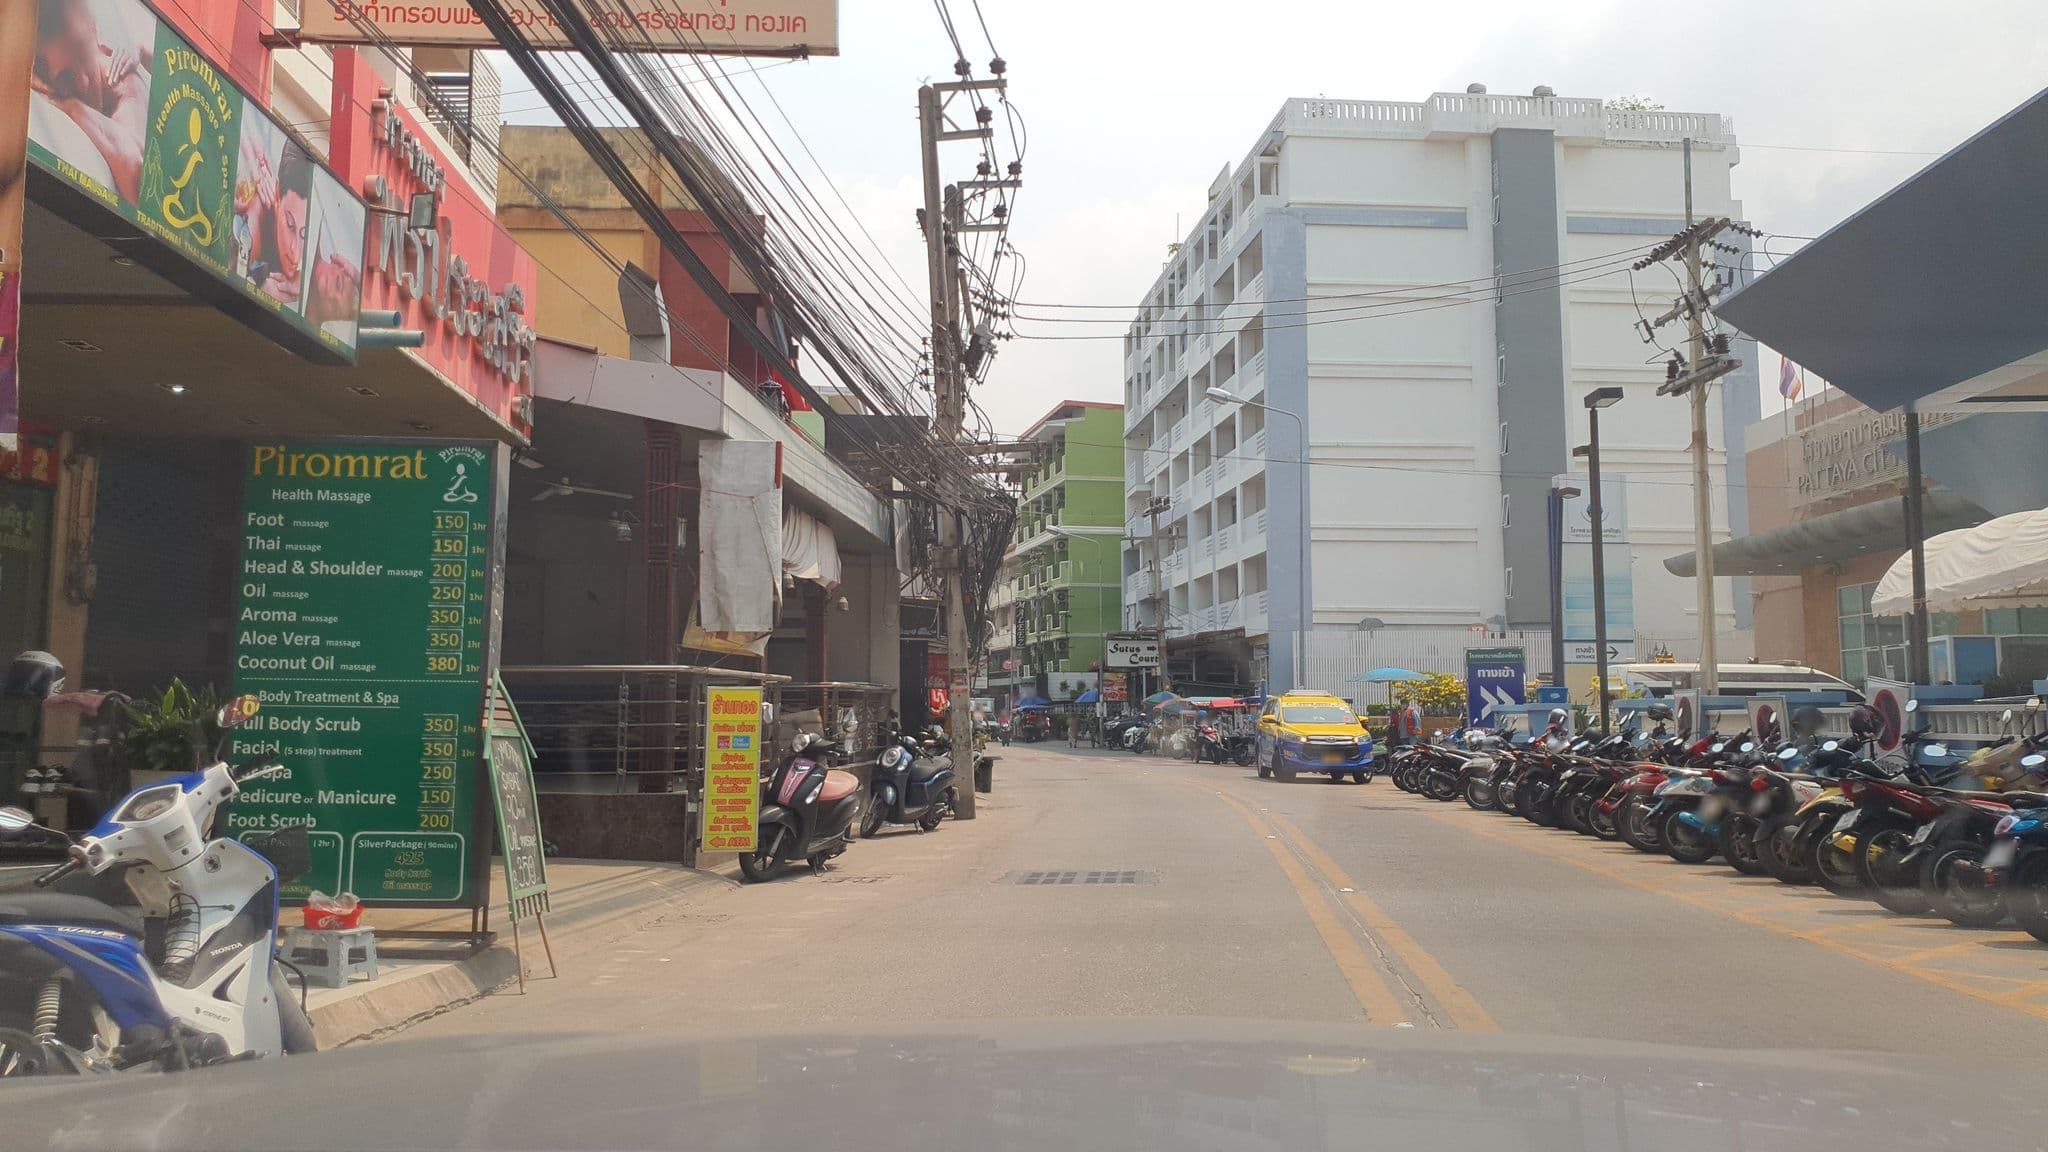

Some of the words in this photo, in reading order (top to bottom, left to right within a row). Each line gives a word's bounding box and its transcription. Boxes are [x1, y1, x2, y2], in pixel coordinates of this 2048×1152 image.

[745, 15, 807, 32] ทองเค
[165, 48, 233, 127] Piromrat
[156, 88, 181, 135] Health
[182, 83, 220, 130] Massage
[56, 158, 79, 181] THAI
[136, 209, 182, 246] TRADITIONAL
[253, 445, 428, 480] Piromrat
[1798, 457, 1859, 496] PATTAYA
[1862, 447, 1897, 474] CIT
[272, 489, 313, 501] Health
[317, 489, 371, 504] Massage
[247, 512, 284, 527] Foot
[293, 520, 329, 529] massage
[435, 515, 464, 529] 150
[472, 522, 487, 531] 1hr
[246, 536, 281, 550] Thai
[285, 543, 322, 552] massage
[434, 539, 464, 552] 150
[471, 545, 486, 554] 1hr
[245, 560, 287, 574] Head
[292, 561, 305, 574] &
[310, 561, 383, 576] Shoulder
[387, 568, 424, 577] massage
[433, 564, 462, 577] 200
[470, 569, 484, 578] 1hr
[243, 583, 266, 598] Oil
[273, 590, 309, 600] massage
[432, 586, 461, 600] 250
[469, 593, 483, 602] 1hr
[241, 608, 297, 621] Aroma
[302, 615, 338, 624] massage
[431, 610, 459, 624] 350
[468, 617, 482, 625] 1hr
[239, 631, 278, 645] Aloe
[282, 632, 321, 646] Vera
[326, 639, 361, 648] massage
[430, 633, 459, 647] 350
[466, 640, 480, 649] 1hr
[1109, 642, 1141, 653] Sutus
[238, 655, 308, 670] Coconut
[311, 655, 335, 670] Oil
[340, 663, 376, 672] massage
[428, 657, 458, 671] 380
[466, 664, 480, 673] 1hr
[1129, 653, 1159, 665] Court
[1477, 666, 1515, 678] ทางเข้า
[259, 690, 291, 704] Body
[294, 691, 360, 703] Treatment
[363, 692, 373, 703] &
[376, 692, 399, 705] Spa
[713, 695, 758, 715] ร้านทอง
[234, 716, 264, 731] ull
[269, 717, 310, 734] Body
[315, 717, 361, 732] Scrub
[424, 719, 453, 732] 350
[463, 725, 476, 734] 1hr
[233, 740, 280, 755] Facial
[295, 747, 317, 757] step)
[318, 747, 362, 756] treatment
[423, 743, 453, 756] 350
[461, 749, 476, 757] 1hr
[262, 764, 292, 782] Spa
[423, 766, 452, 780] 250
[304, 796, 313, 804] or
[318, 790, 397, 805] Manicure
[421, 790, 450, 804] 150
[228, 813, 265, 827] Foot
[270, 813, 317, 828] Scrub
[420, 814, 449, 828] 200
[358, 839, 384, 848] Silver
[385, 840, 423, 849] Package
[210, 942, 244, 956] HONDA
